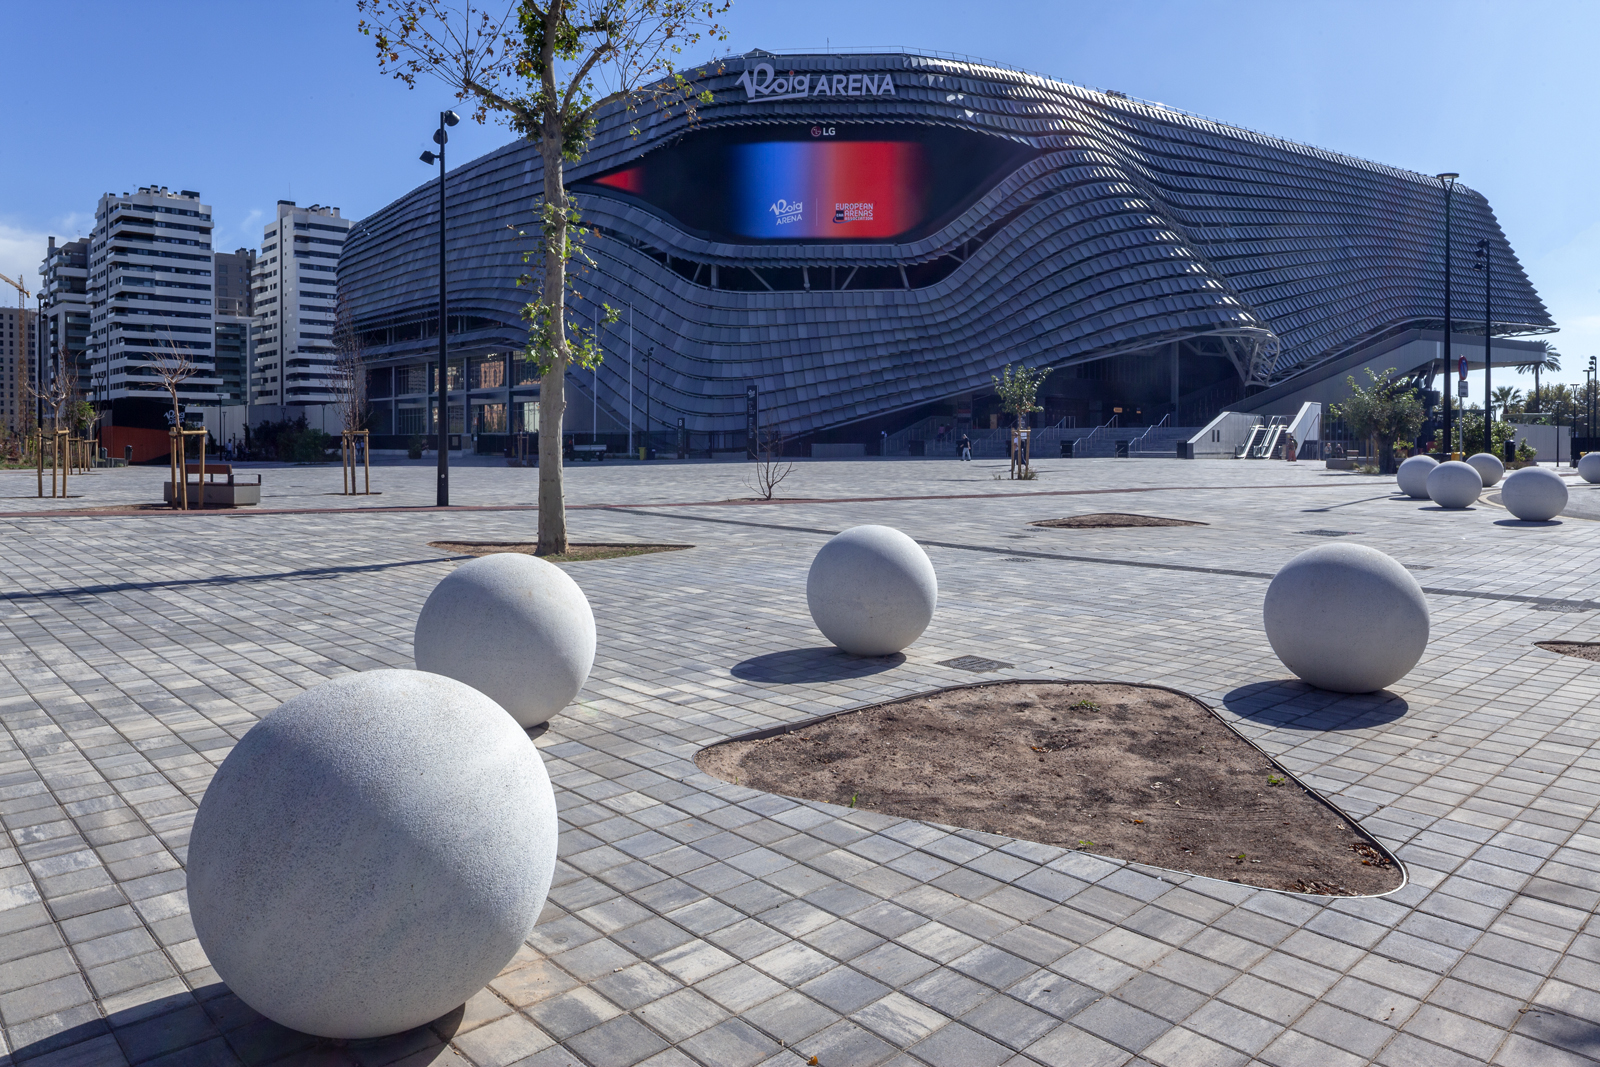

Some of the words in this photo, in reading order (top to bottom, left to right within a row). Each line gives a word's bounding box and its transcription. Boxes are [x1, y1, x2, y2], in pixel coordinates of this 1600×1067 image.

[735, 63, 811, 103] Roig
[813, 74, 896, 96] ARENA
[823, 127, 836, 136] LG
[769, 199, 803, 217] Roig
[776, 214, 803, 226] ARENA
